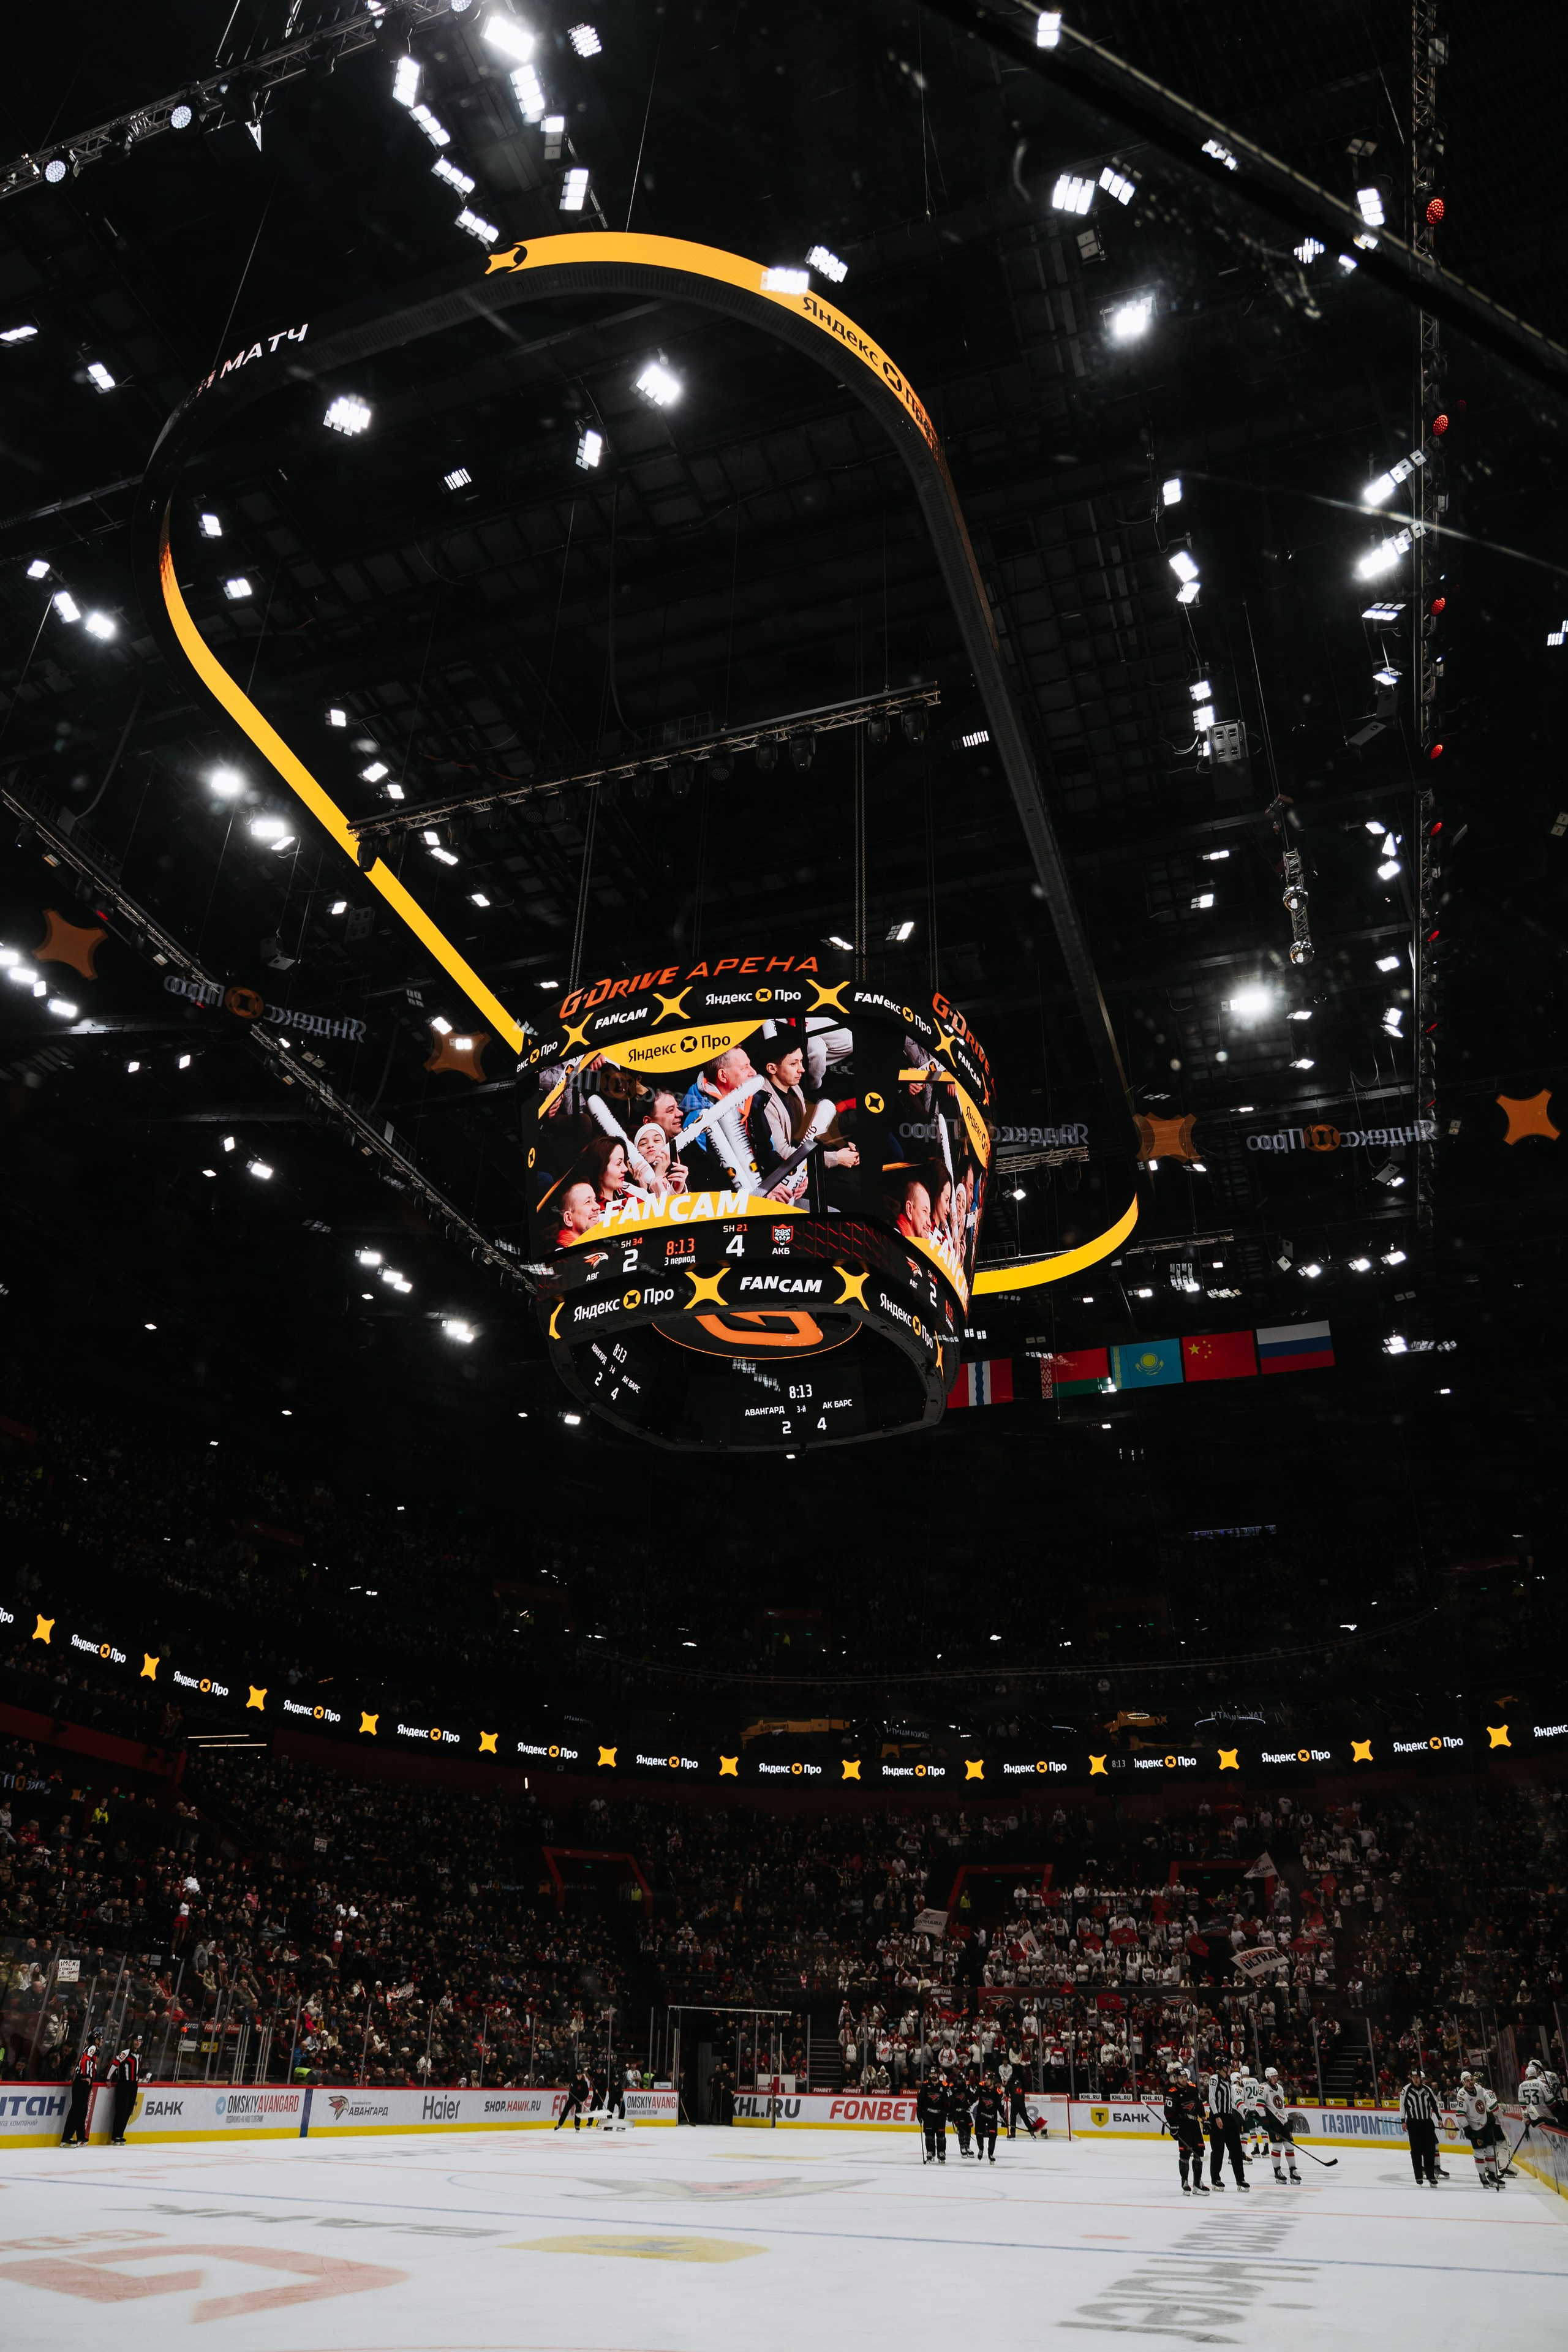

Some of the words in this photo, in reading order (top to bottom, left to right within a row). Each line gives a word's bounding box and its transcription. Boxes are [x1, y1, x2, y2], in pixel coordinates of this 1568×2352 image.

[803, 296, 878, 367] Яндекс
[219, 323, 308, 379] МАТЧ
[685, 956, 818, 980] АРЕНА
[705, 992, 753, 1006] Яндекс
[775, 989, 802, 1002] Про
[594, 1007, 648, 1030] FANCAM
[914, 1014, 932, 1035] Про
[516, 1057, 529, 1072] екс
[540, 1041, 558, 1057] Про
[628, 1042, 677, 1063] Яндекс
[701, 1035, 731, 1049] Про
[957, 1050, 982, 1088] FANCAM
[966, 1106, 982, 1140] Яндекс
[602, 1188, 750, 1229] FANCAM
[723, 1224, 735, 1233] SH
[632, 1237, 643, 1246] 34
[666, 1238, 695, 1256] 8:13
[725, 1234, 745, 1257] 4
[622, 1249, 639, 1273] 2
[664, 1257, 669, 1266] 3
[671, 1256, 696, 1265] период
[586, 1272, 600, 1282] АВГ
[739, 1276, 822, 1294] FANCAM
[909, 1278, 919, 1290] АВГ
[929, 1281, 938, 1308] 2
[573, 1297, 620, 1322] Яндекс
[643, 1287, 674, 1305] Про
[880, 1292, 913, 1328] Яндекс
[921, 1324, 934, 1349] Про
[590, 1343, 608, 1366] АВАНГАРД
[612, 1343, 628, 1364] 8:13
[594, 1371, 603, 1387] 2
[621, 1375, 630, 1385] АК
[627, 1379, 641, 1394] БАРС
[611, 1387, 619, 1401] 4
[789, 1384, 813, 1400] 8:13
[744, 1405, 785, 1417] АВАНГАРД
[834, 1398, 853, 1408] БАРС
[782, 1420, 791, 1434] 2
[816, 1417, 827, 1430] 4
[70, 1634, 100, 1654] Яндекс
[110, 1648, 126, 1663] Про
[173, 1671, 199, 1689] Яндекс
[211, 1683, 228, 1696] Про
[284, 1700, 313, 1716] Яндекс
[324, 1709, 341, 1722] Про
[397, 1724, 429, 1738] Яндекс
[442, 1731, 460, 1743] Про
[1533, 1723, 1568, 1738] Яндекс
[518, 1742, 547, 1755] Яндекс
[560, 1747, 578, 1759] Про
[1393, 1741, 1428, 1753] Яндекс
[1443, 1736, 1463, 1749] Про
[636, 1755, 667, 1766] Яндекс
[680, 1758, 698, 1770] Про
[1112, 1760, 1126, 1768] 8:13
[1177, 1756, 1197, 1768] Про
[1262, 1752, 1296, 1763] Яндекс
[1311, 1749, 1330, 1761] Про
[758, 1763, 790, 1774] Яндекс
[804, 1764, 822, 1774] Про
[882, 1766, 914, 1776] Яндекс
[927, 1766, 945, 1777] Про
[1003, 1763, 1035, 1774] Яндекс
[1049, 1762, 1067, 1773] Про
[227, 2095, 300, 2114] OMSKIYAVANGARD
[1522, 2089, 1540, 2106] 53
[145, 2101, 184, 2116] БАНК
[348, 2106, 388, 2117] АВАНГАРД
[422, 2094, 461, 2120] Haier
[484, 2100, 541, 2113] SHOP.HAWK.RU
[829, 2100, 919, 2122] FONBET
[9, 2118, 38, 2127] компаний
[1113, 2113, 1150, 2123] БАНК
[1322, 2114, 1405, 2136] ГАЗПРОМНЕФ
